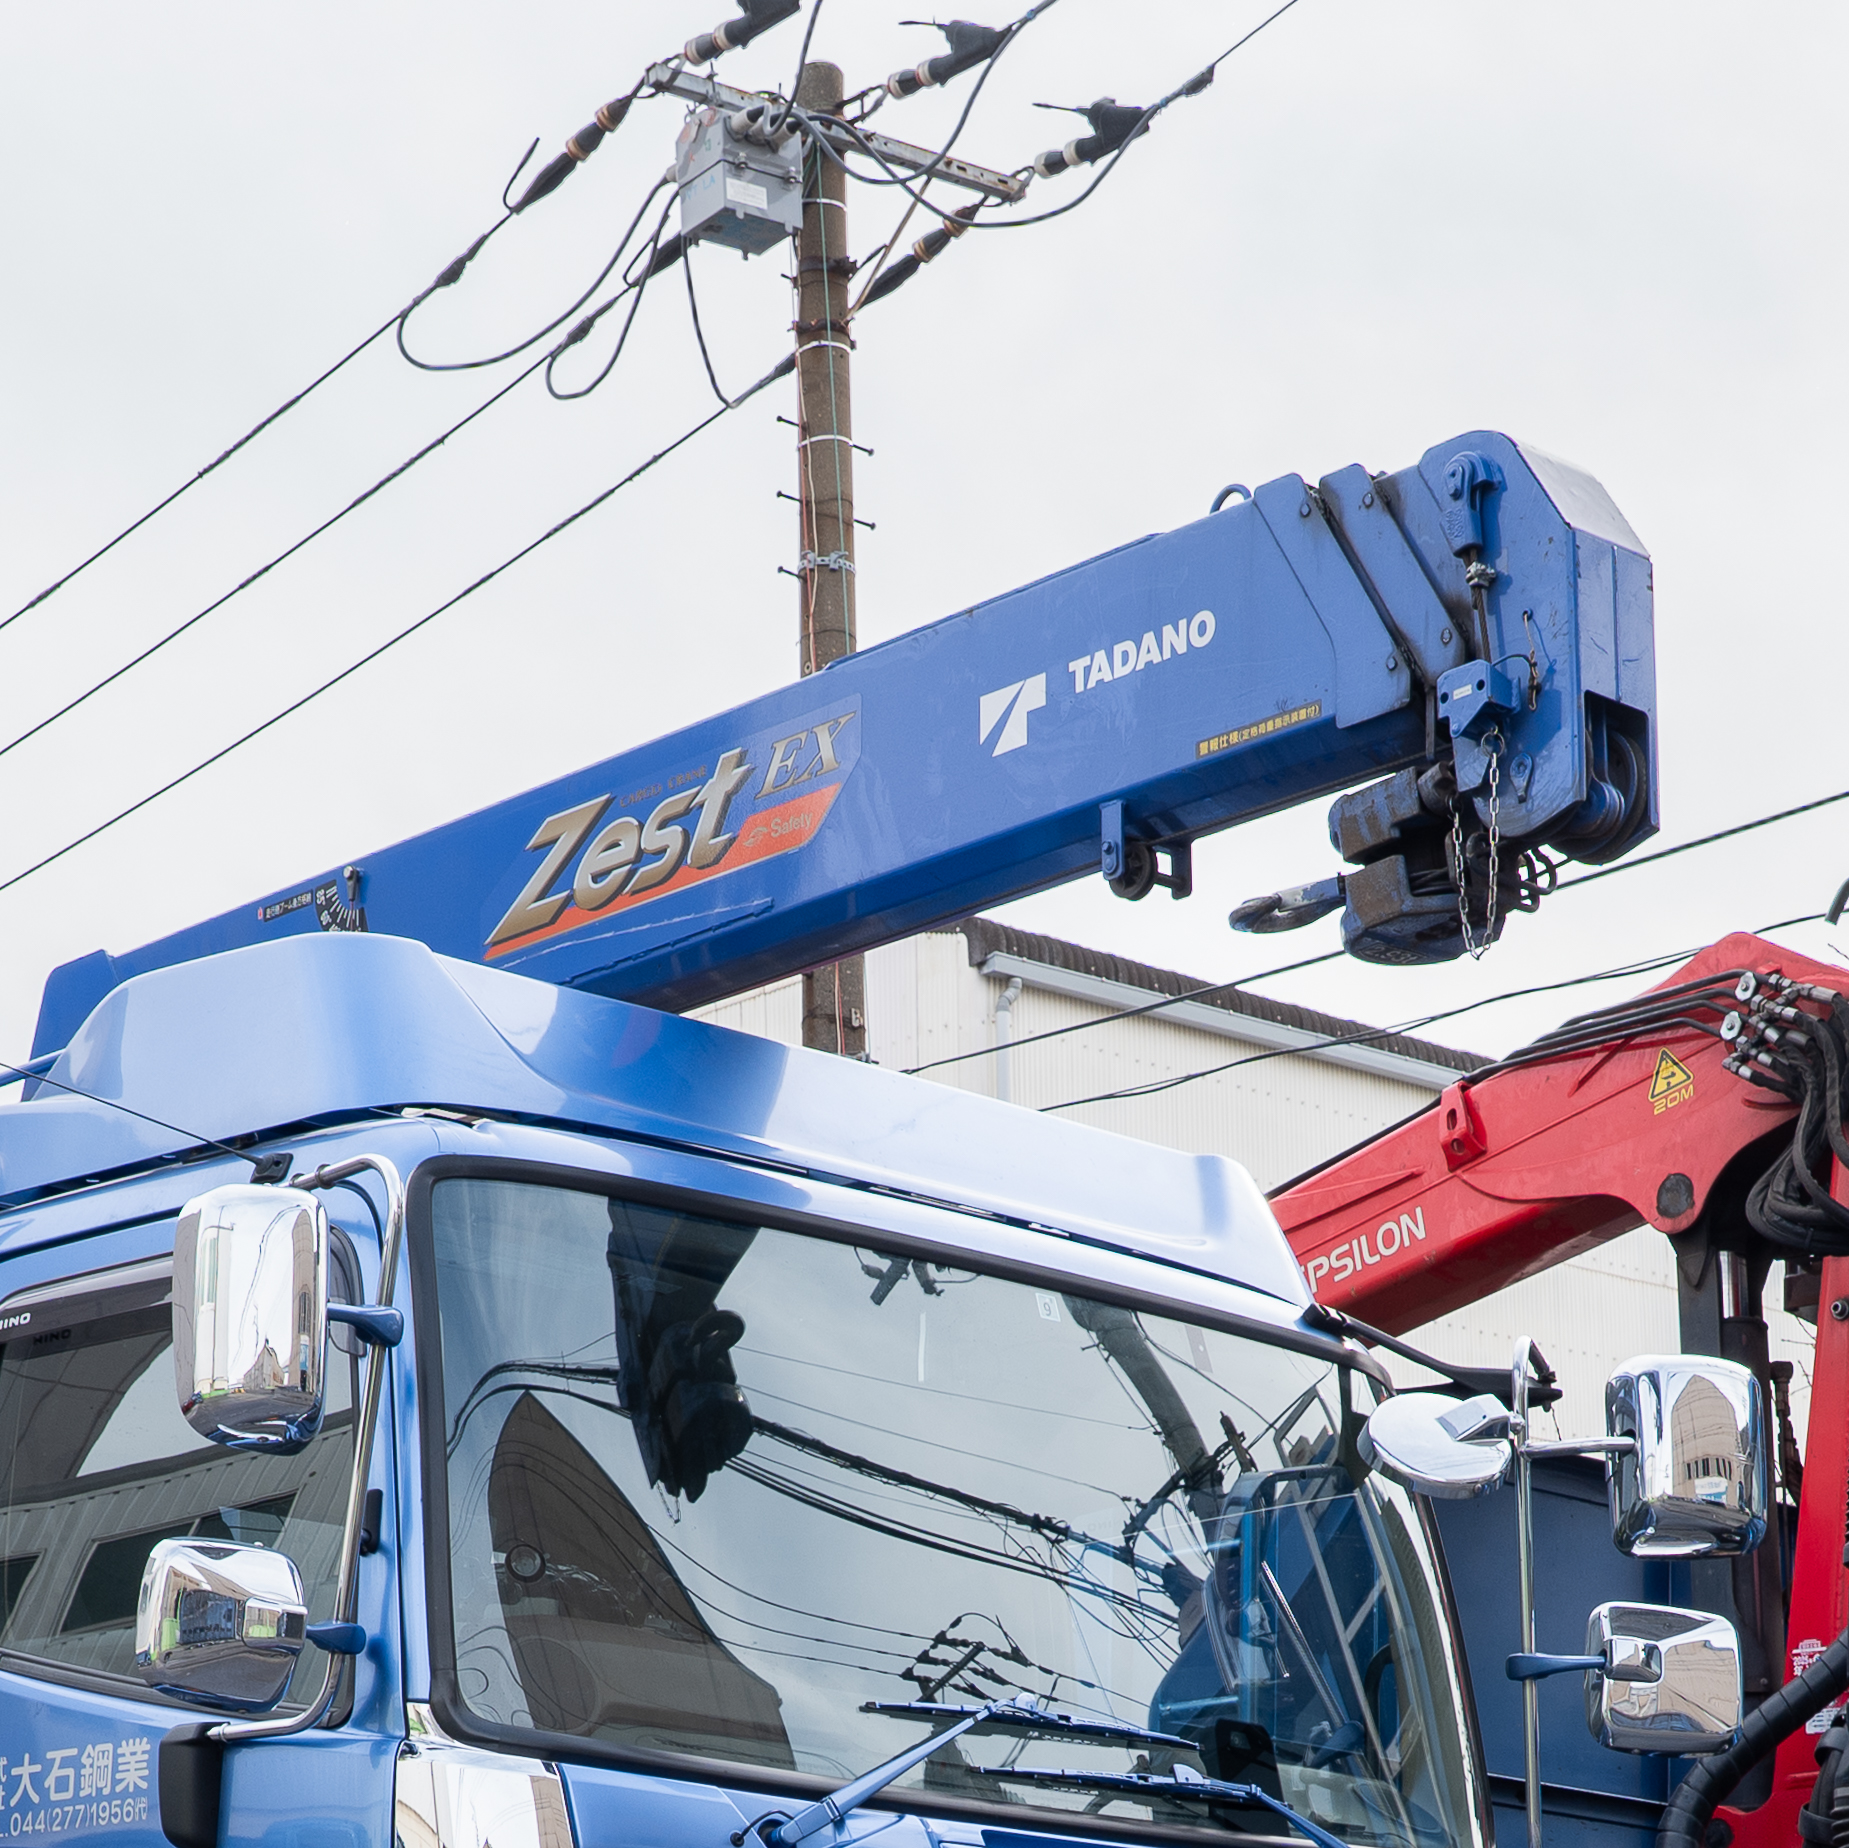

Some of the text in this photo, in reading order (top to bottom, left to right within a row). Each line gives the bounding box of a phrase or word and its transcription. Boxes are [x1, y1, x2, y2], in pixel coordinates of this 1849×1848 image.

[1069, 609, 1216, 694] TADANO
[755, 711, 857, 799] EX
[484, 746, 757, 946] Zest
[770, 811, 813, 839] Safety
[1654, 1083, 1694, 1116] 20M
[1301, 1205, 1427, 1294] PSILON
[11, 1738, 150, 1804] 大石鋼業
